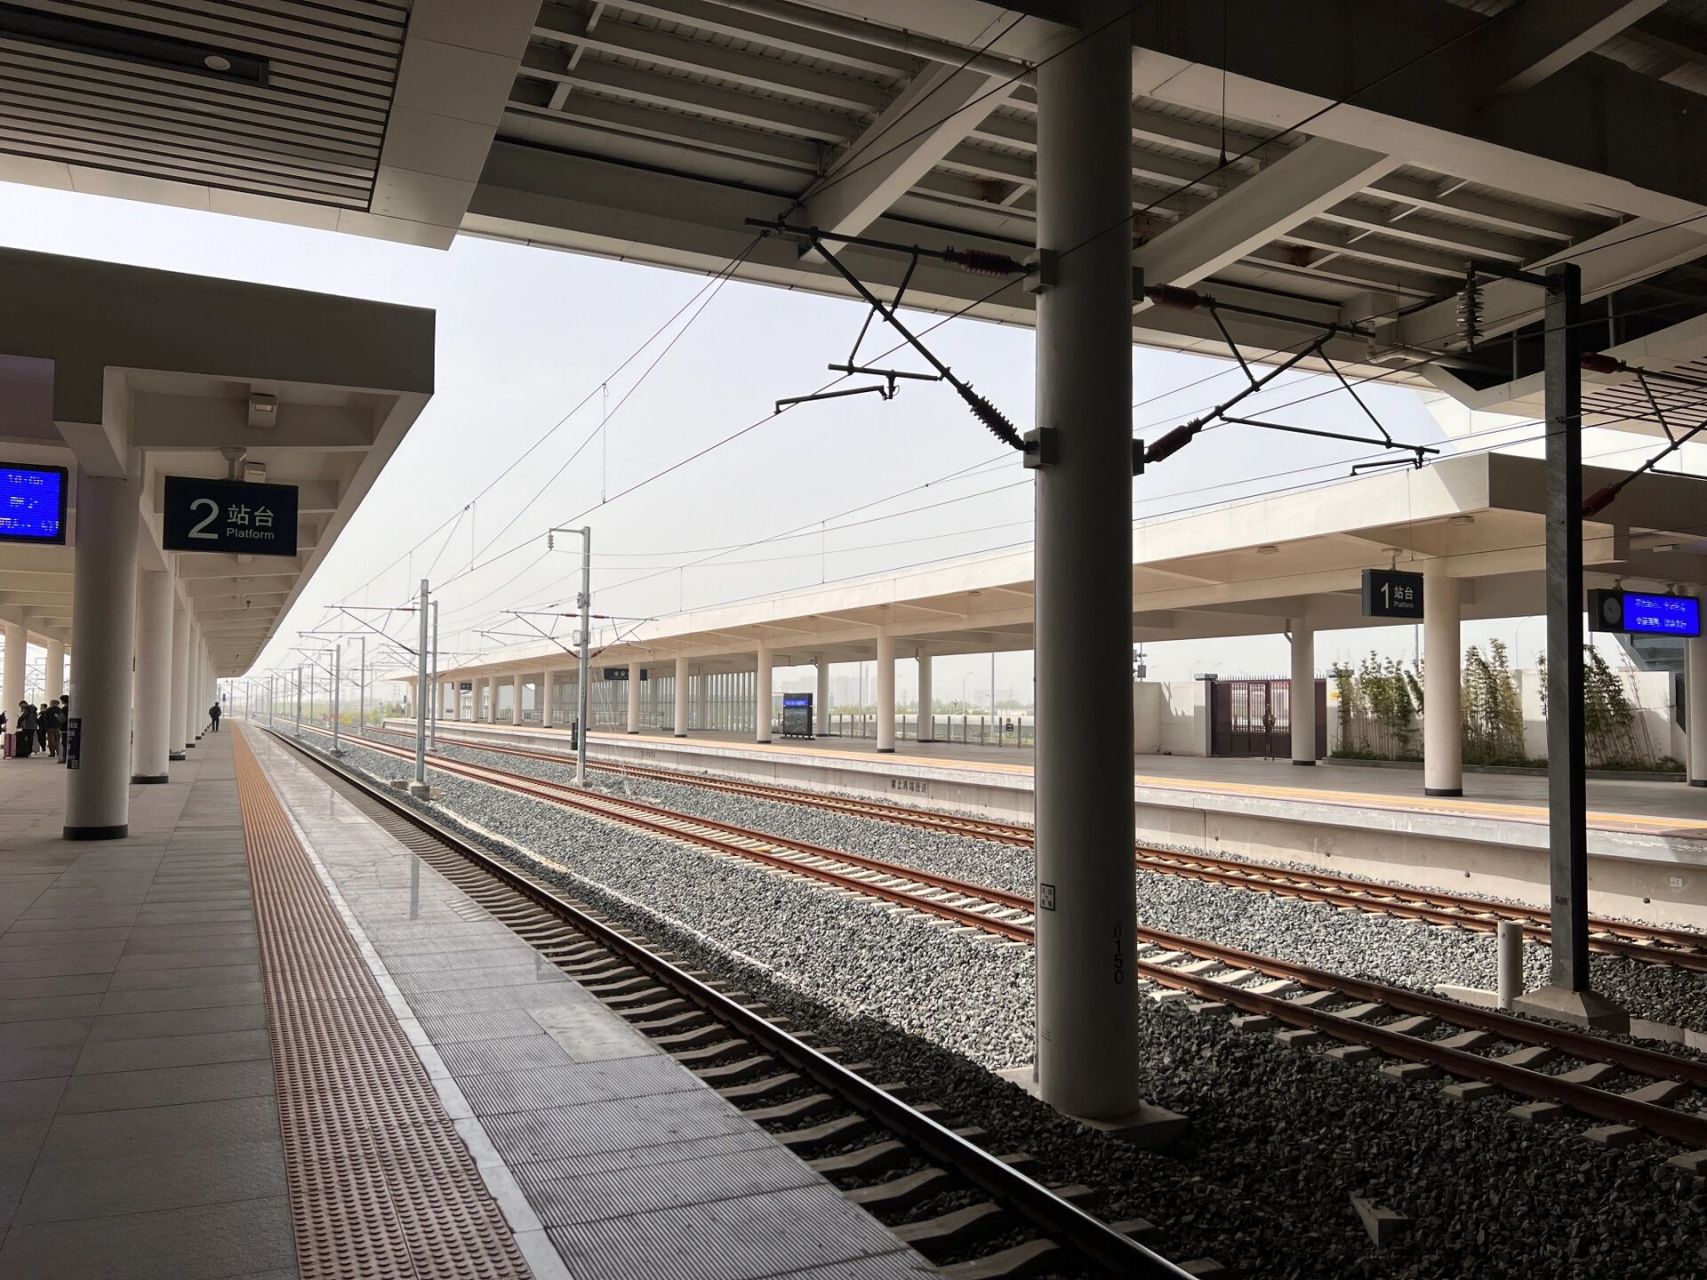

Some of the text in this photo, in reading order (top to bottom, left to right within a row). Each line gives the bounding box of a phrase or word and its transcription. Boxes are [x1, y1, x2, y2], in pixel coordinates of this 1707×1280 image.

[188, 498, 274, 540] 2 站台
[226, 528, 275, 540] Platform
[1380, 582, 1414, 609] 1 站台
